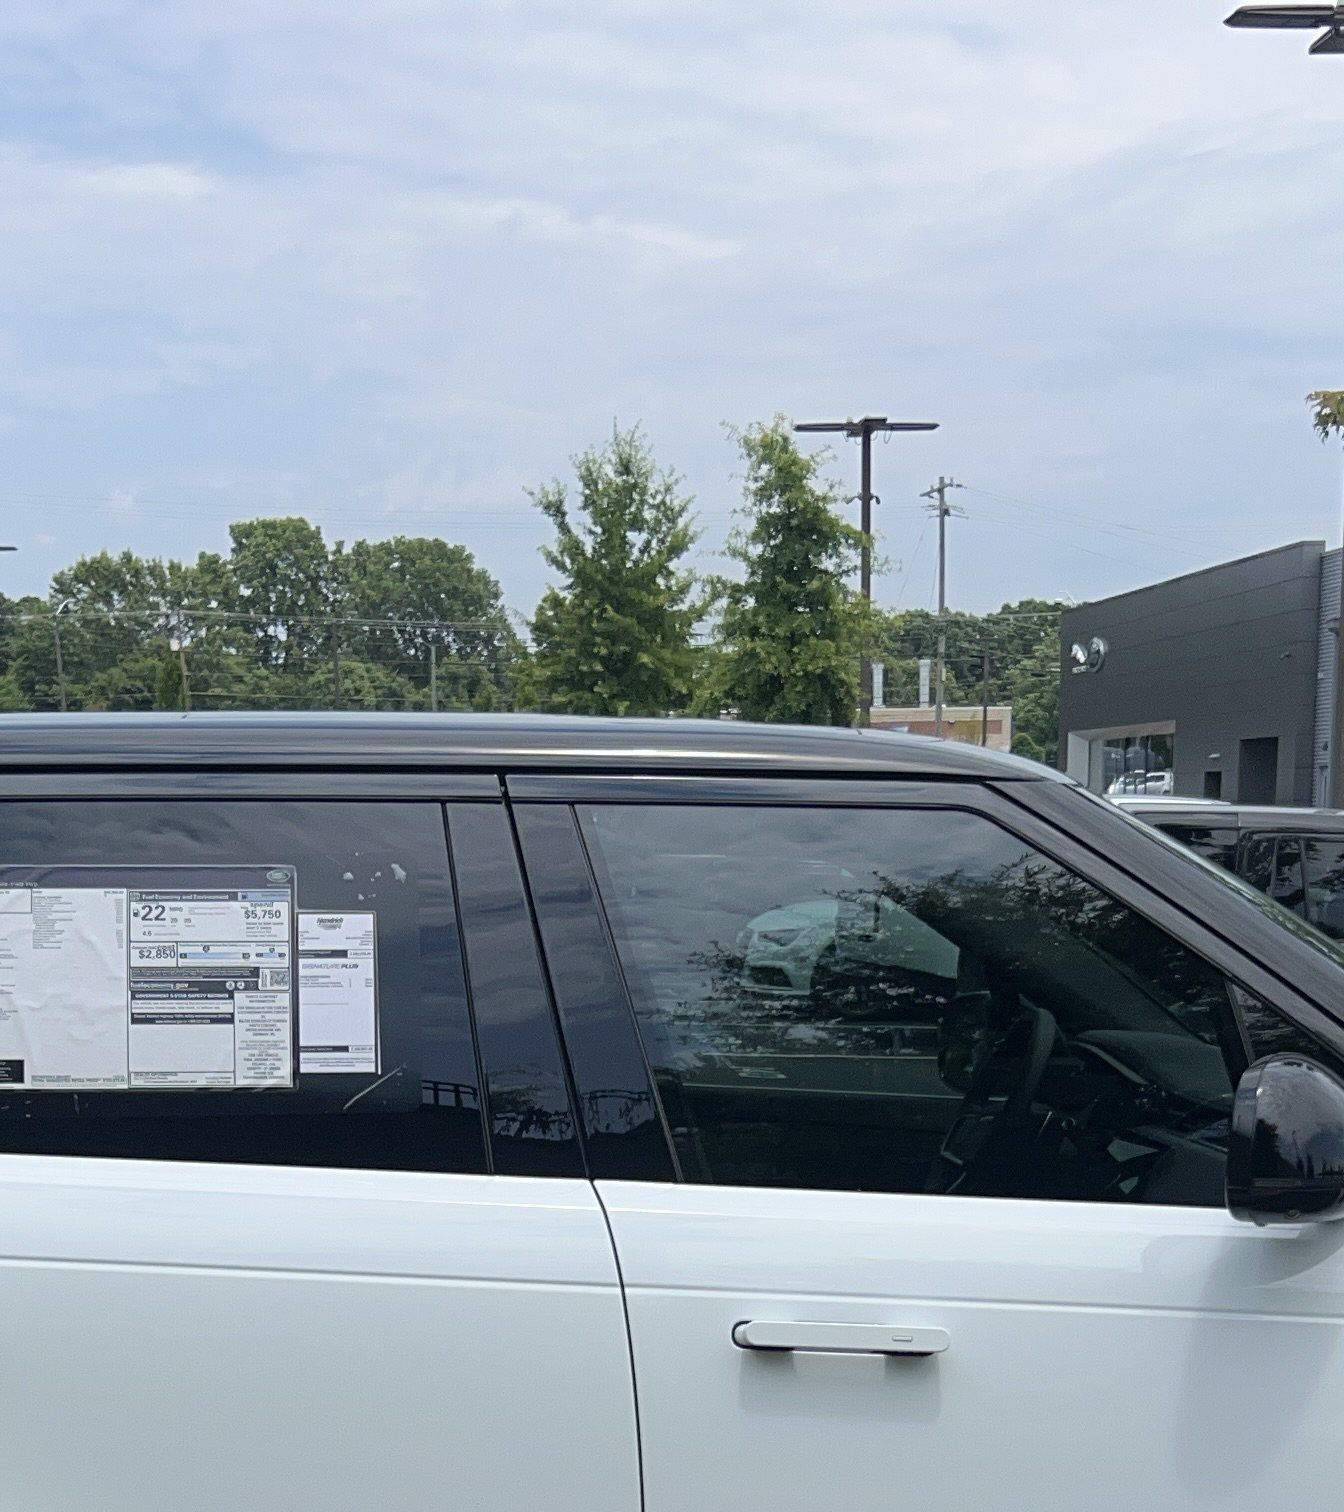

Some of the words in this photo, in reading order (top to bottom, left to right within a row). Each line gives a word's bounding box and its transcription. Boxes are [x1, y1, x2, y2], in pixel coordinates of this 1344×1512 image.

[141, 904, 167, 922] 22
[244, 909, 282, 920] $5,750
[138, 949, 176, 960] $2,850
